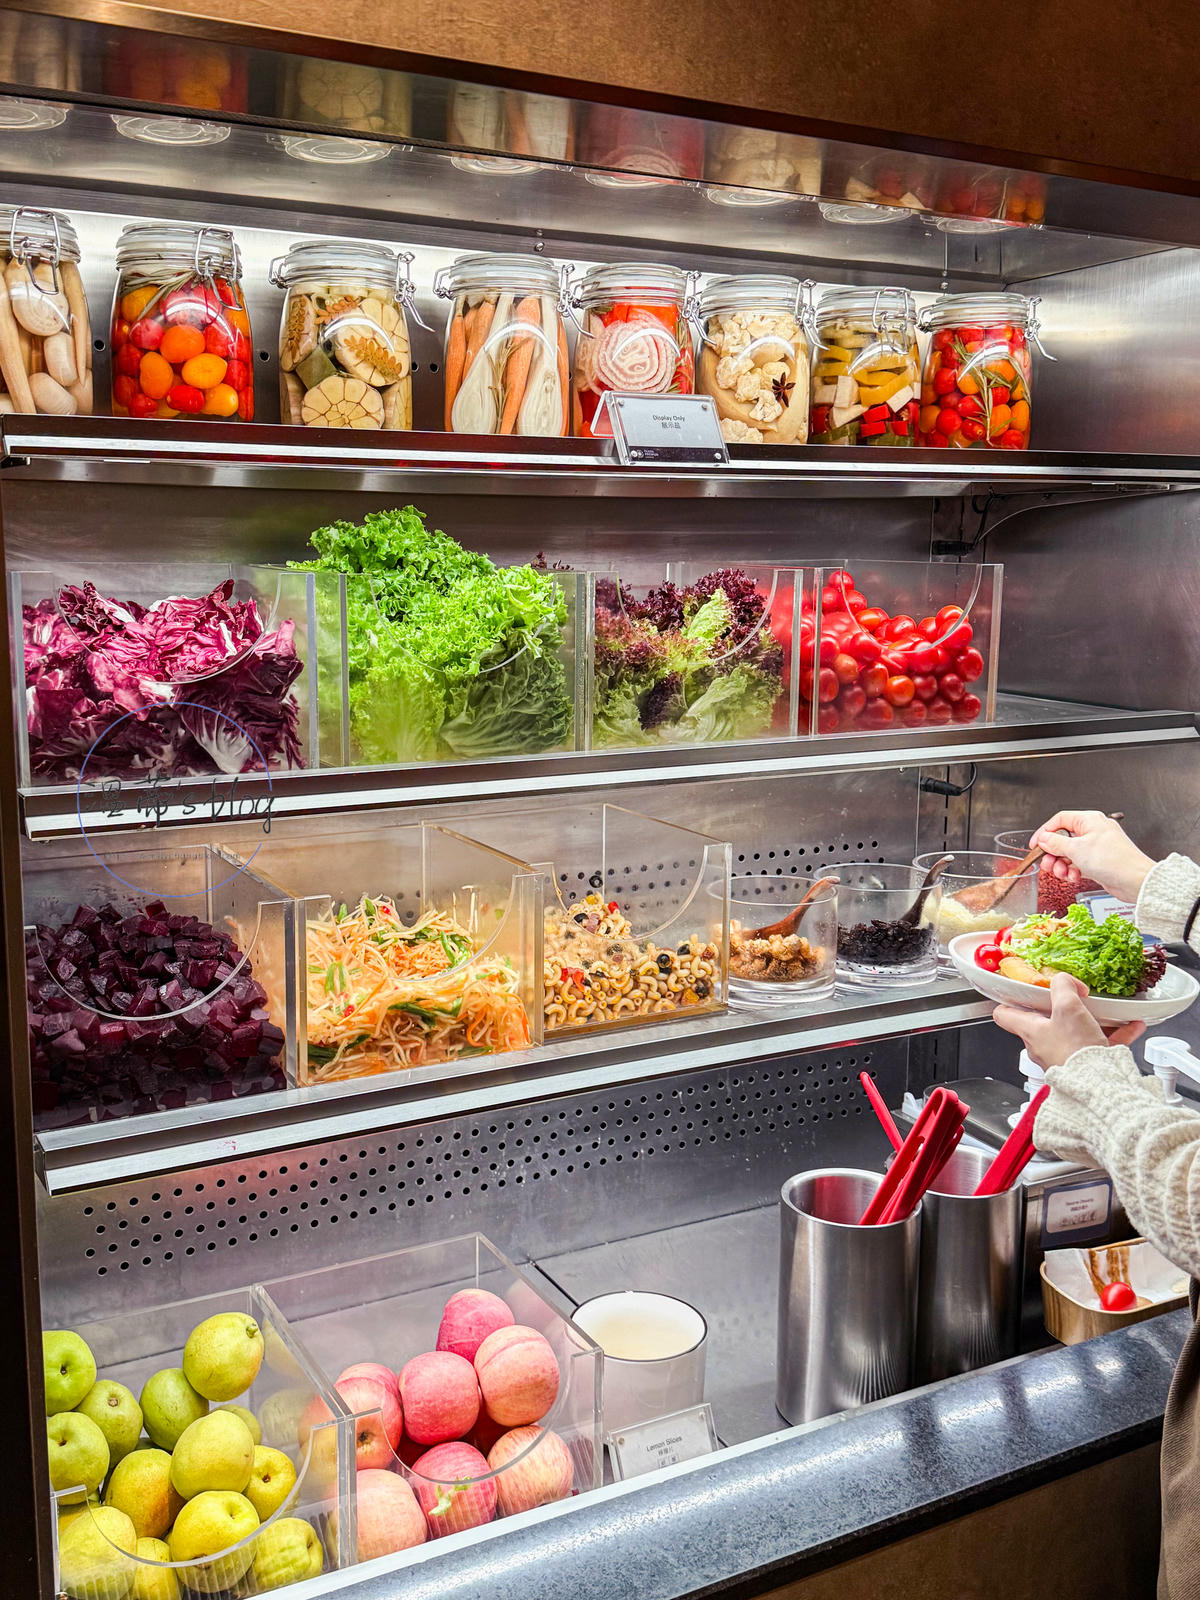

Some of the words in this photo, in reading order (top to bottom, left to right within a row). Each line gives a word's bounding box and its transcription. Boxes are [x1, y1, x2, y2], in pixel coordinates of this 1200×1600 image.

[652, 414, 672, 422] Display
[646, 1441, 666, 1452] Lemon
[665, 1436, 682, 1446] Slices
